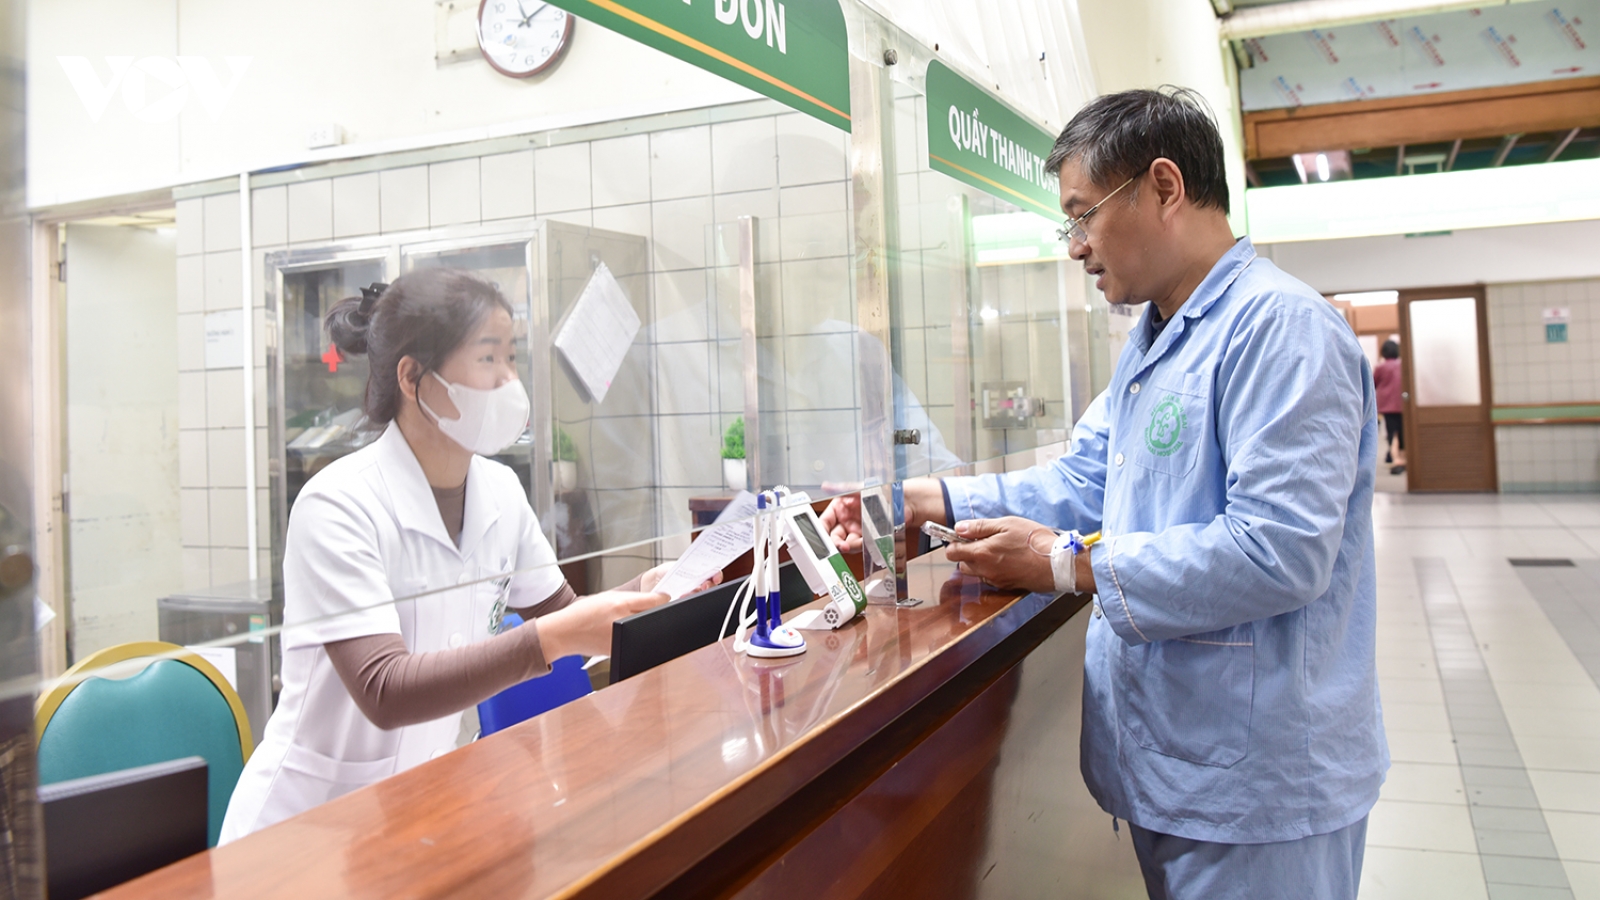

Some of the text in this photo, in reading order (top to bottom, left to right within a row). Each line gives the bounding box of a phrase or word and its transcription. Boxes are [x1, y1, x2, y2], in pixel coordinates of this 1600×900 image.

[553, 9, 564, 22] 3
[550, 29, 560, 39] 4
[541, 46, 550, 57] 5
[509, 53, 517, 63] 7
[524, 54, 535, 66] 6
[989, 127, 1034, 184] THANH
